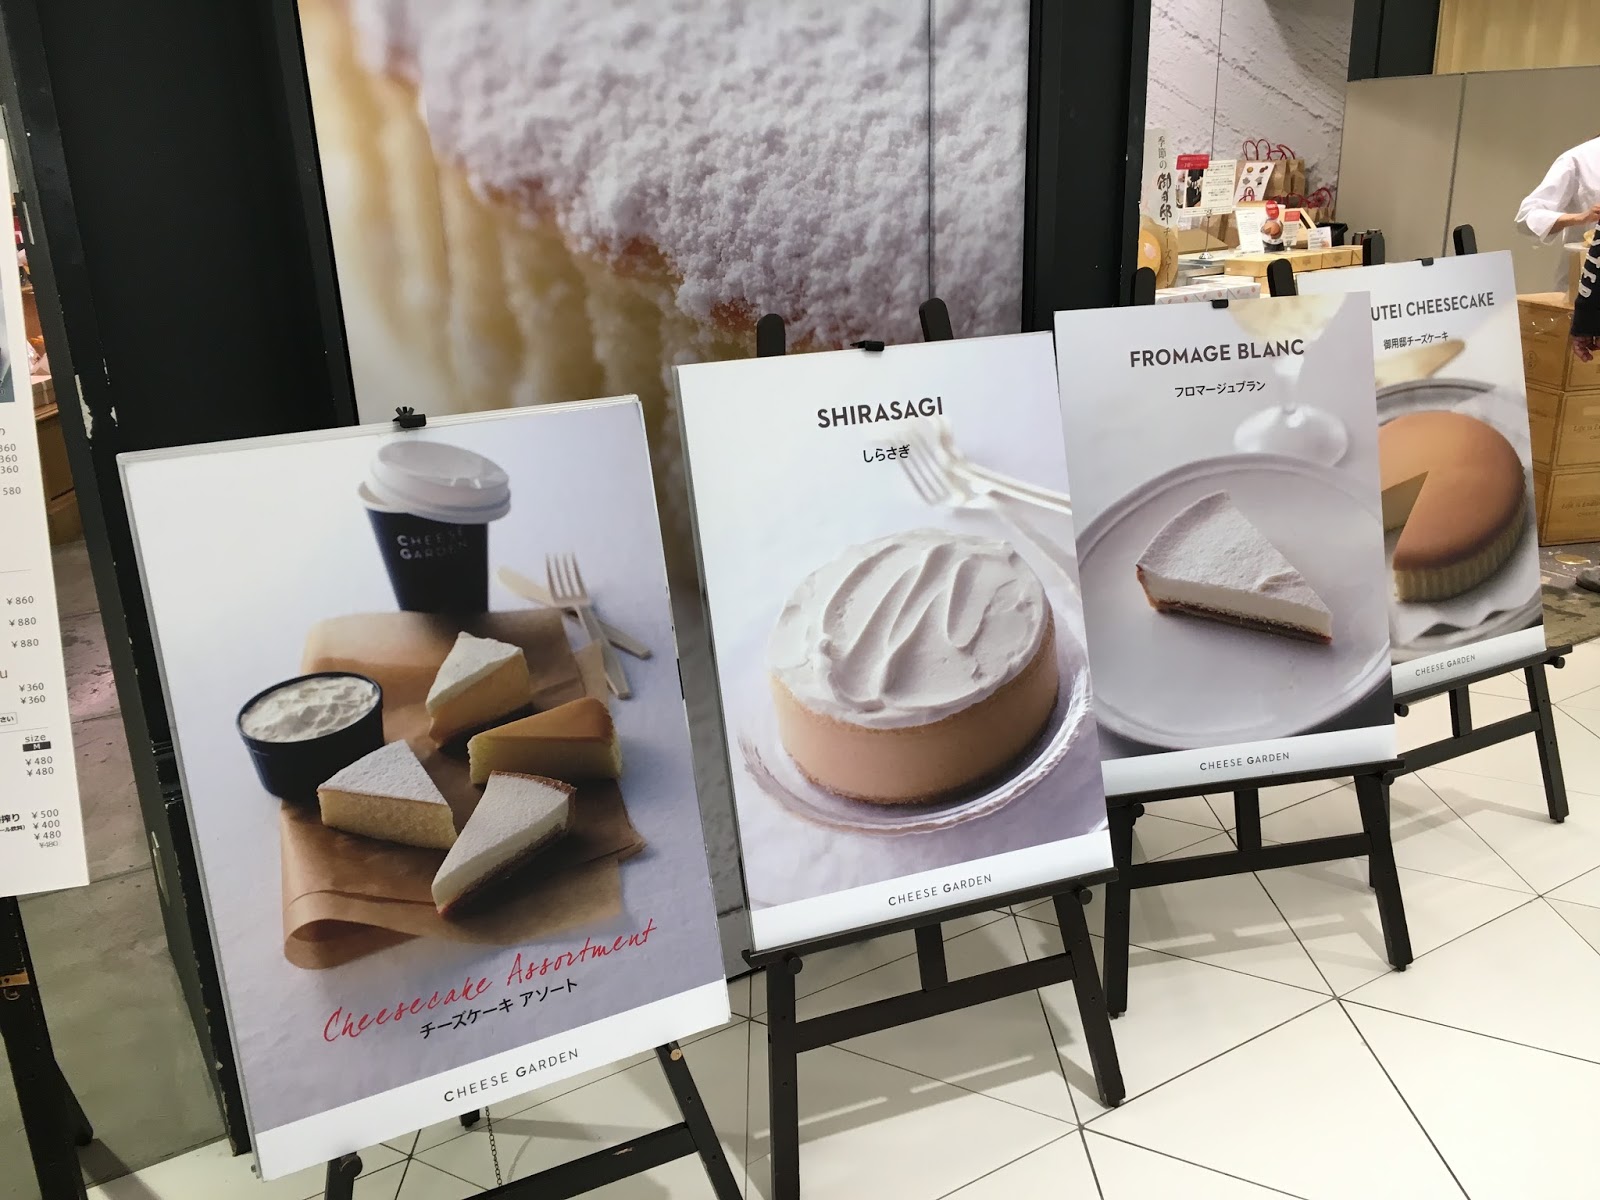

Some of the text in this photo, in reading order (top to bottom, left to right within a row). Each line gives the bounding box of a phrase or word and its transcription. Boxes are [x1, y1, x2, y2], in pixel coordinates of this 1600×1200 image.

[1406, 292, 1495, 317] CHEESECAKE
[1383, 331, 1449, 350] 御用邸チーズケーキ
[1130, 339, 1305, 368] FROMAGE BLANC
[1174, 380, 1266, 398] フロマージュブラン
[817, 396, 943, 428] SHIRASAGI
[863, 444, 911, 463] しらさぎ
[0, 465, 19, 474] 360
[2, 486, 21, 496] 580
[1415, 654, 1476, 677] CHEESE GARDEN
[24, 734, 46, 743] size
[1199, 752, 1290, 771] CHEESE GARDEN
[888, 874, 992, 906] CHEESE GARDEN
[323, 918, 657, 1042] Cheesecake Assortment
[419, 978, 578, 1039] チーズケーキ アソート
[444, 1048, 579, 1103] CHEESE GARDEN
